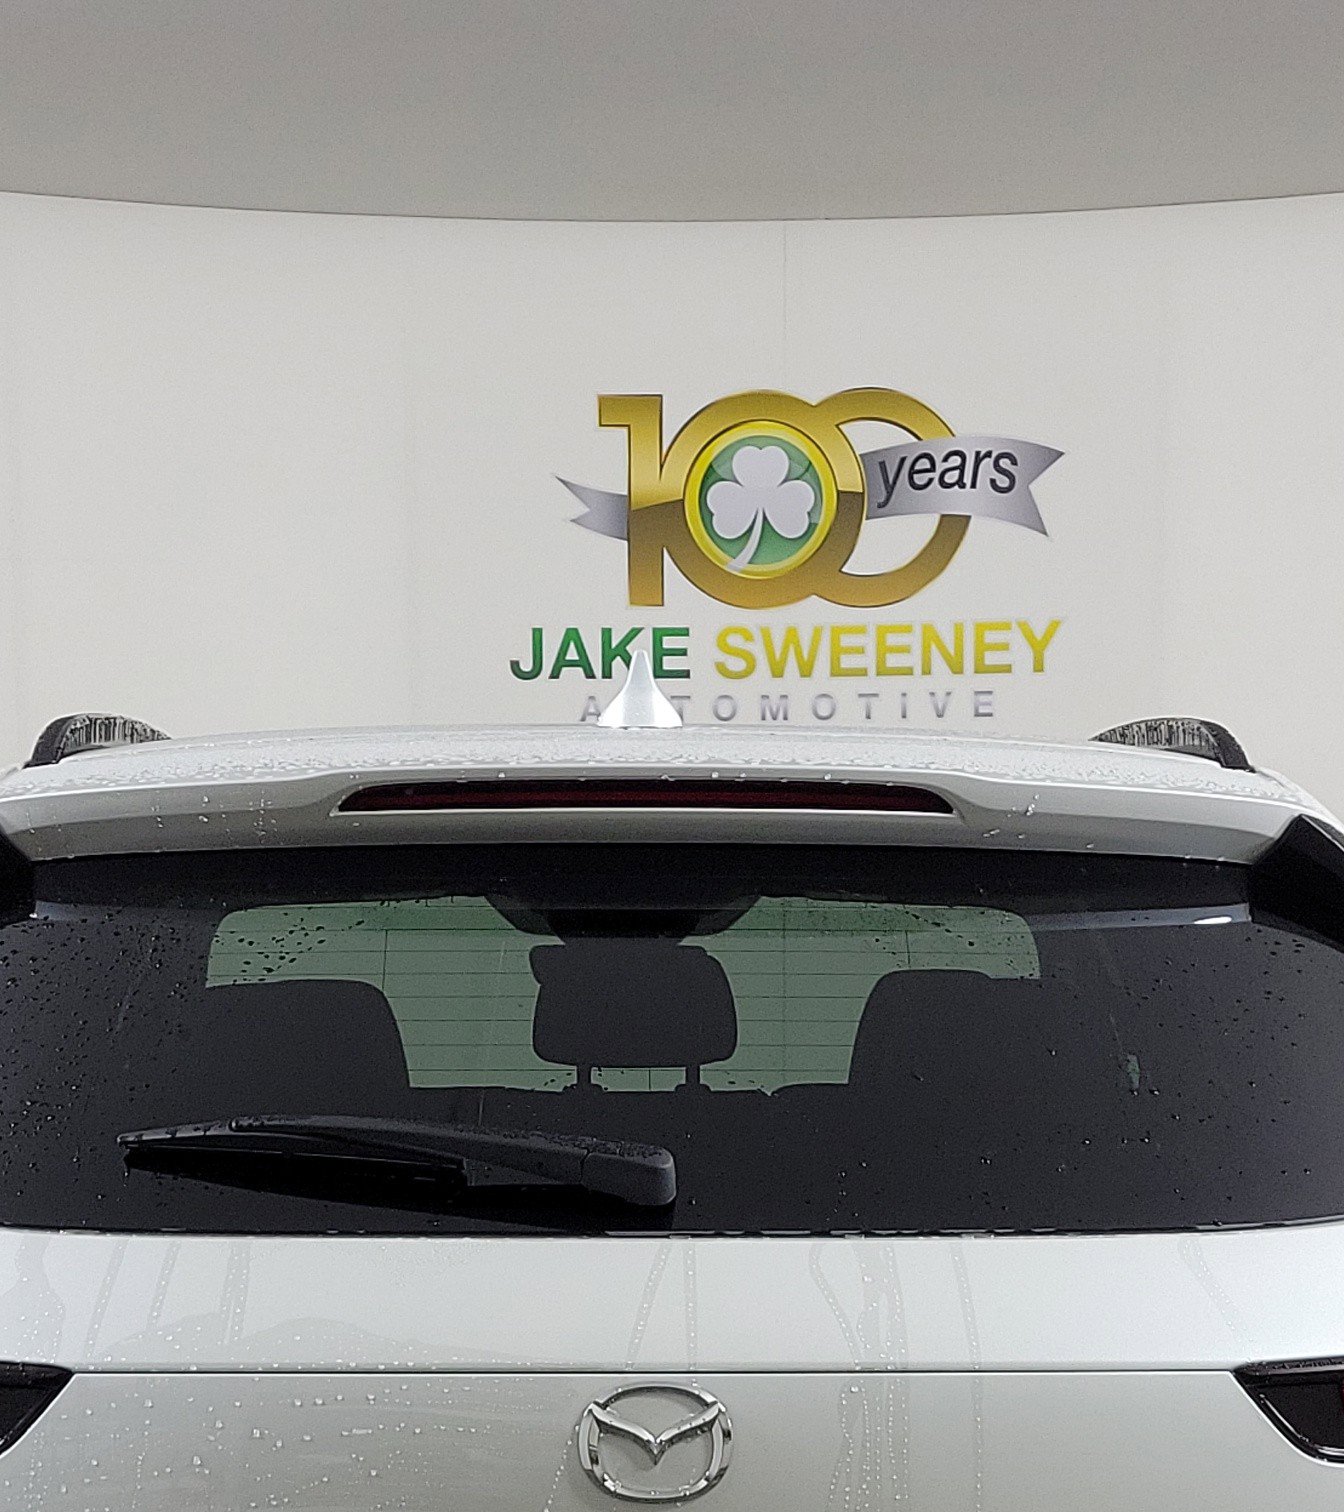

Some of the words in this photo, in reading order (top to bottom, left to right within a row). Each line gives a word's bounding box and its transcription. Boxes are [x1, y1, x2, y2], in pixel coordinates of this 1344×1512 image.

[596, 387, 972, 609] 100
[875, 445, 1019, 509] years
[509, 625, 691, 681] JAKE
[713, 619, 1062, 679] SWEENEY
[580, 690, 996, 723] ATOMOTIVE
